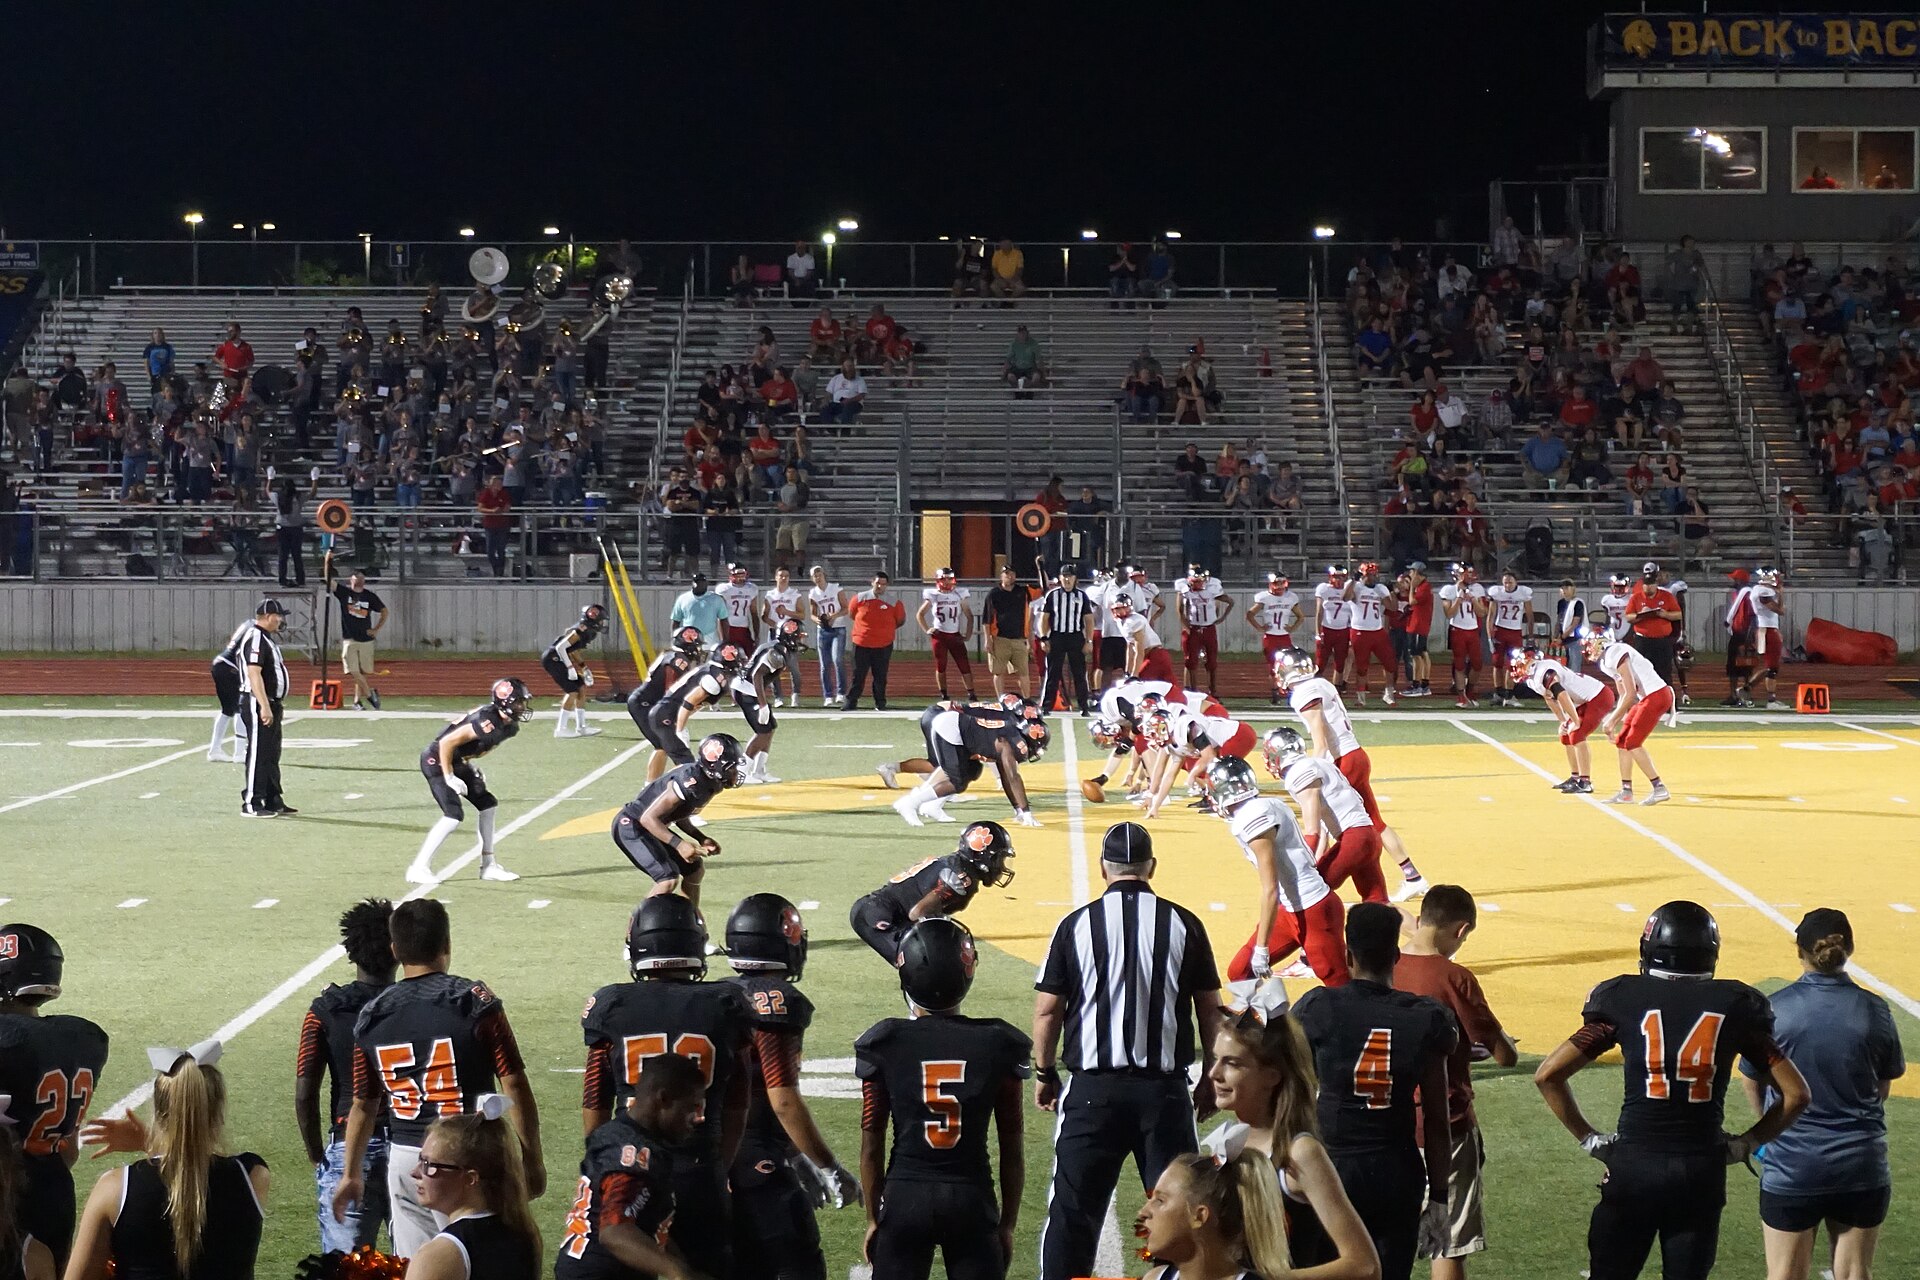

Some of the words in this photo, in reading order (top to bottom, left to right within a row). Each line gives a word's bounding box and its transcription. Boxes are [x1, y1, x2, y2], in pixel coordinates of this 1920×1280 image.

[1668, 19, 1793, 56] BACK
[1796, 29, 1818, 46] to
[1824, 20, 1920, 57] BAC
[1069, 532, 1081, 558] 1
[936, 606, 958, 623] 54
[1273, 611, 1283, 630] 4
[1333, 602, 1343, 619] 7
[1361, 601, 1380, 619] 75
[1500, 605, 1521, 620] 22
[1614, 612, 1623, 630] 5
[314, 684, 337, 705] 20
[1803, 687, 1827, 710] 40
[652, 960, 688, 969] Riddell
[734, 961, 766, 970] Riddell
[755, 990, 787, 1015] 22
[1640, 1009, 1726, 1103] 14
[375, 1037, 464, 1120] 54
[1354, 1028, 1393, 1109] 4
[921, 1060, 967, 1149] 5
[620, 1144, 651, 1171] 84
